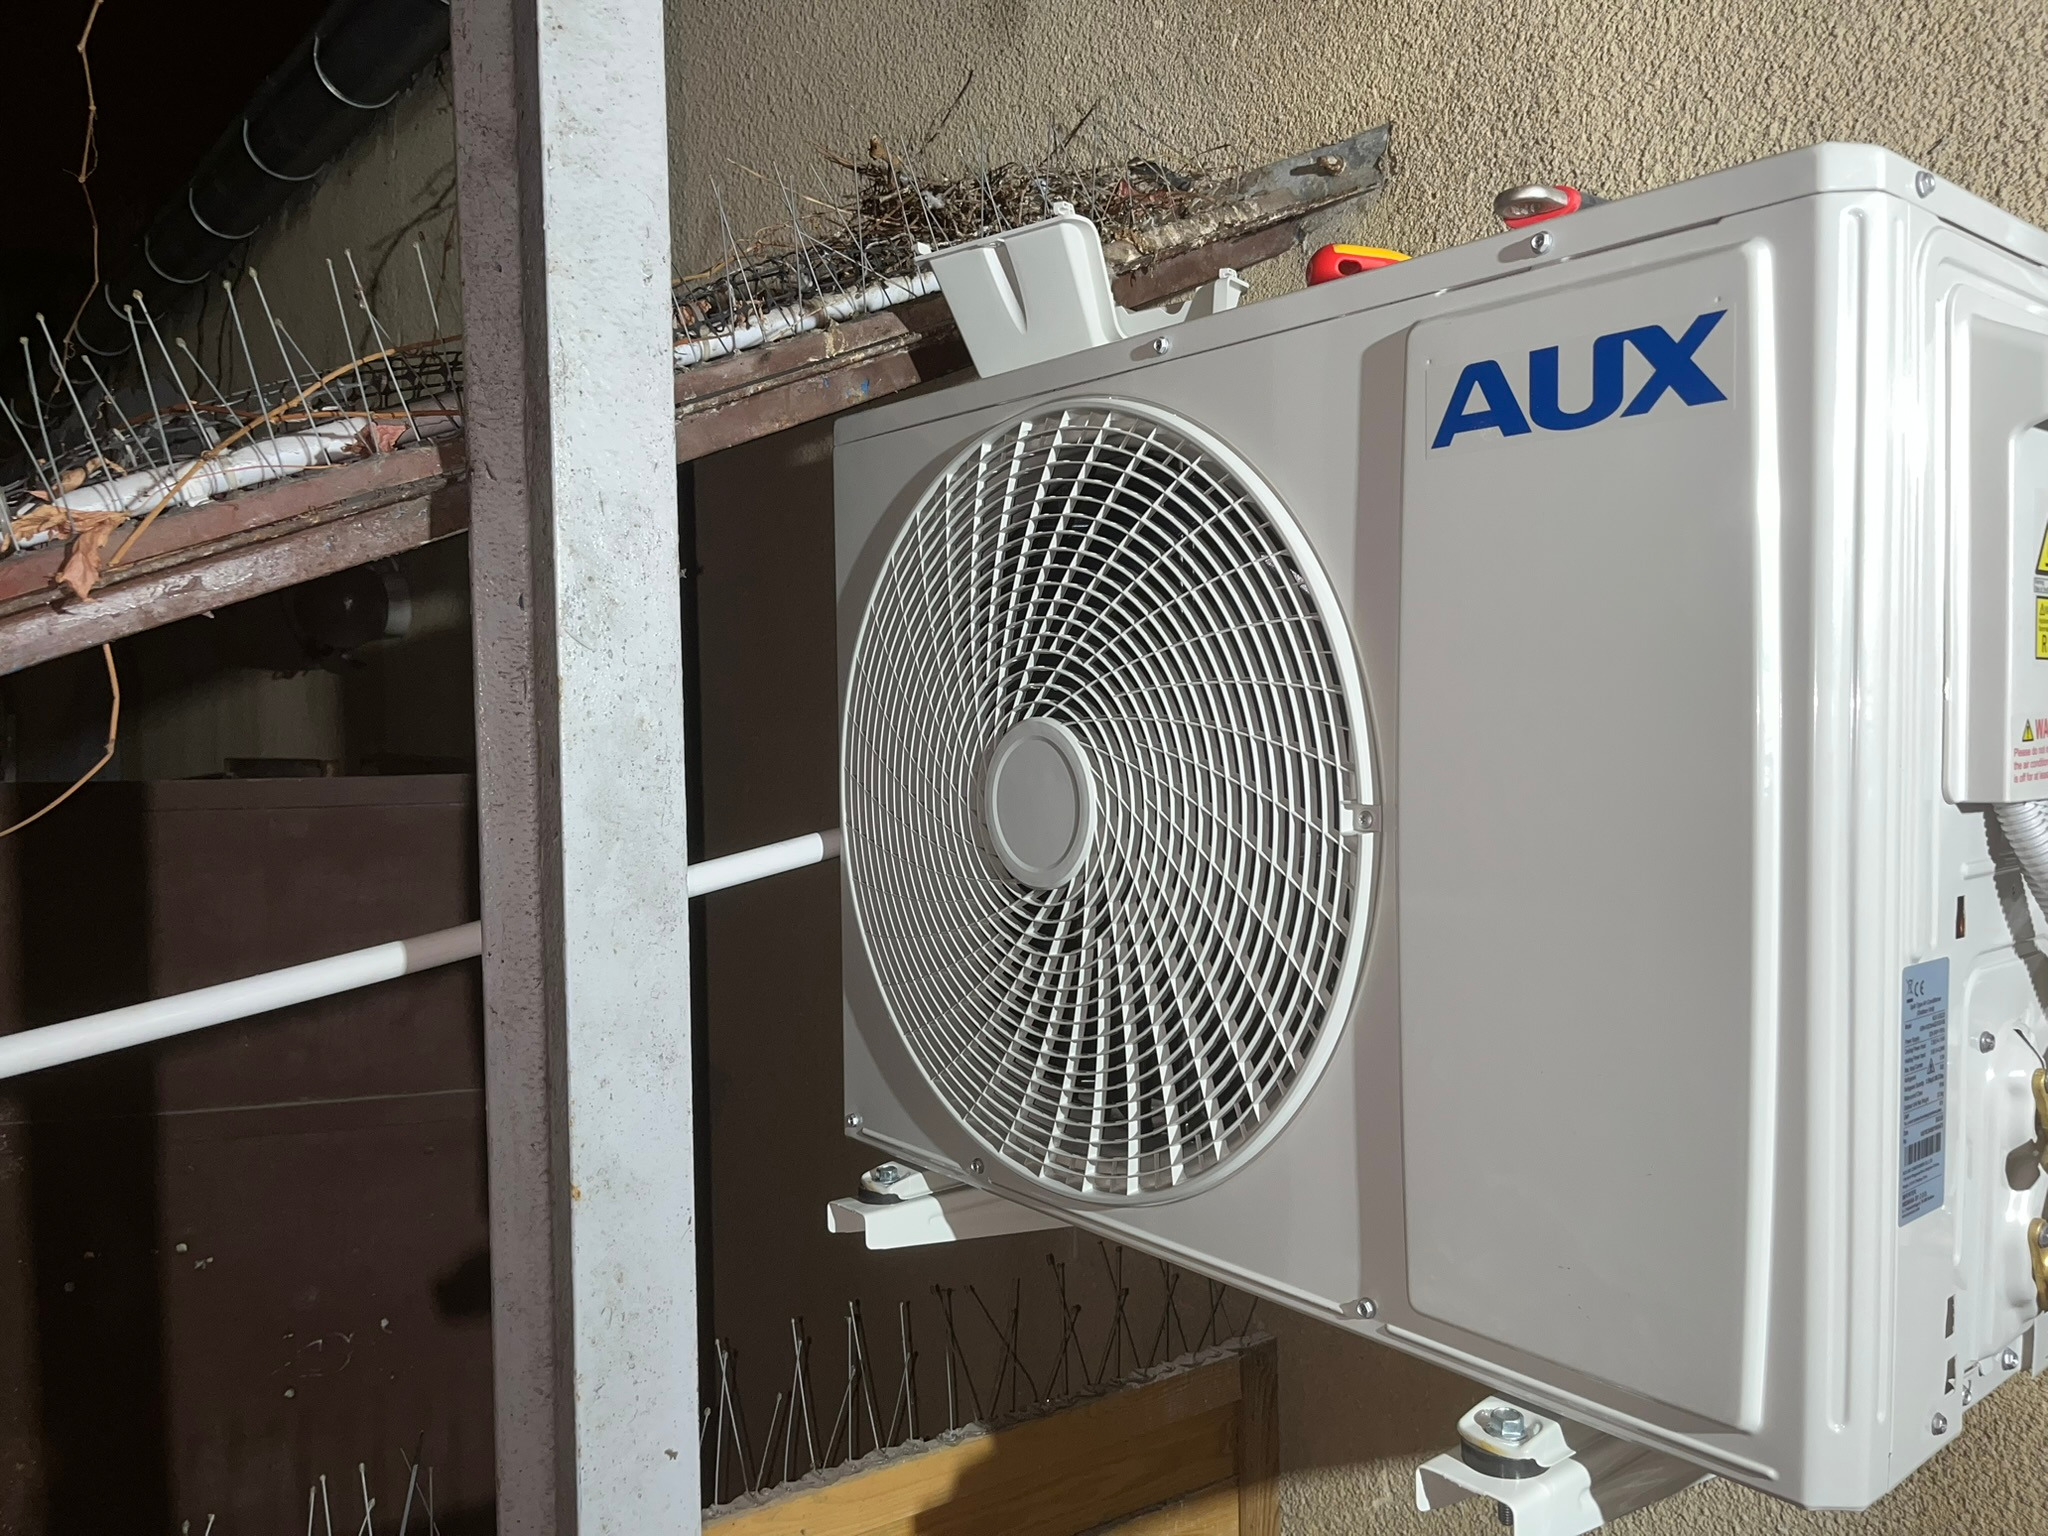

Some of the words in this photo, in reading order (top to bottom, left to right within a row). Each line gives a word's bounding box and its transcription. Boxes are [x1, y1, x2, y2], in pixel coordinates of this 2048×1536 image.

[1431, 309, 1728, 449] AUX
[2014, 748, 2031, 757] Please
[2014, 762, 2022, 770] the
[1914, 980, 1925, 997] CE
